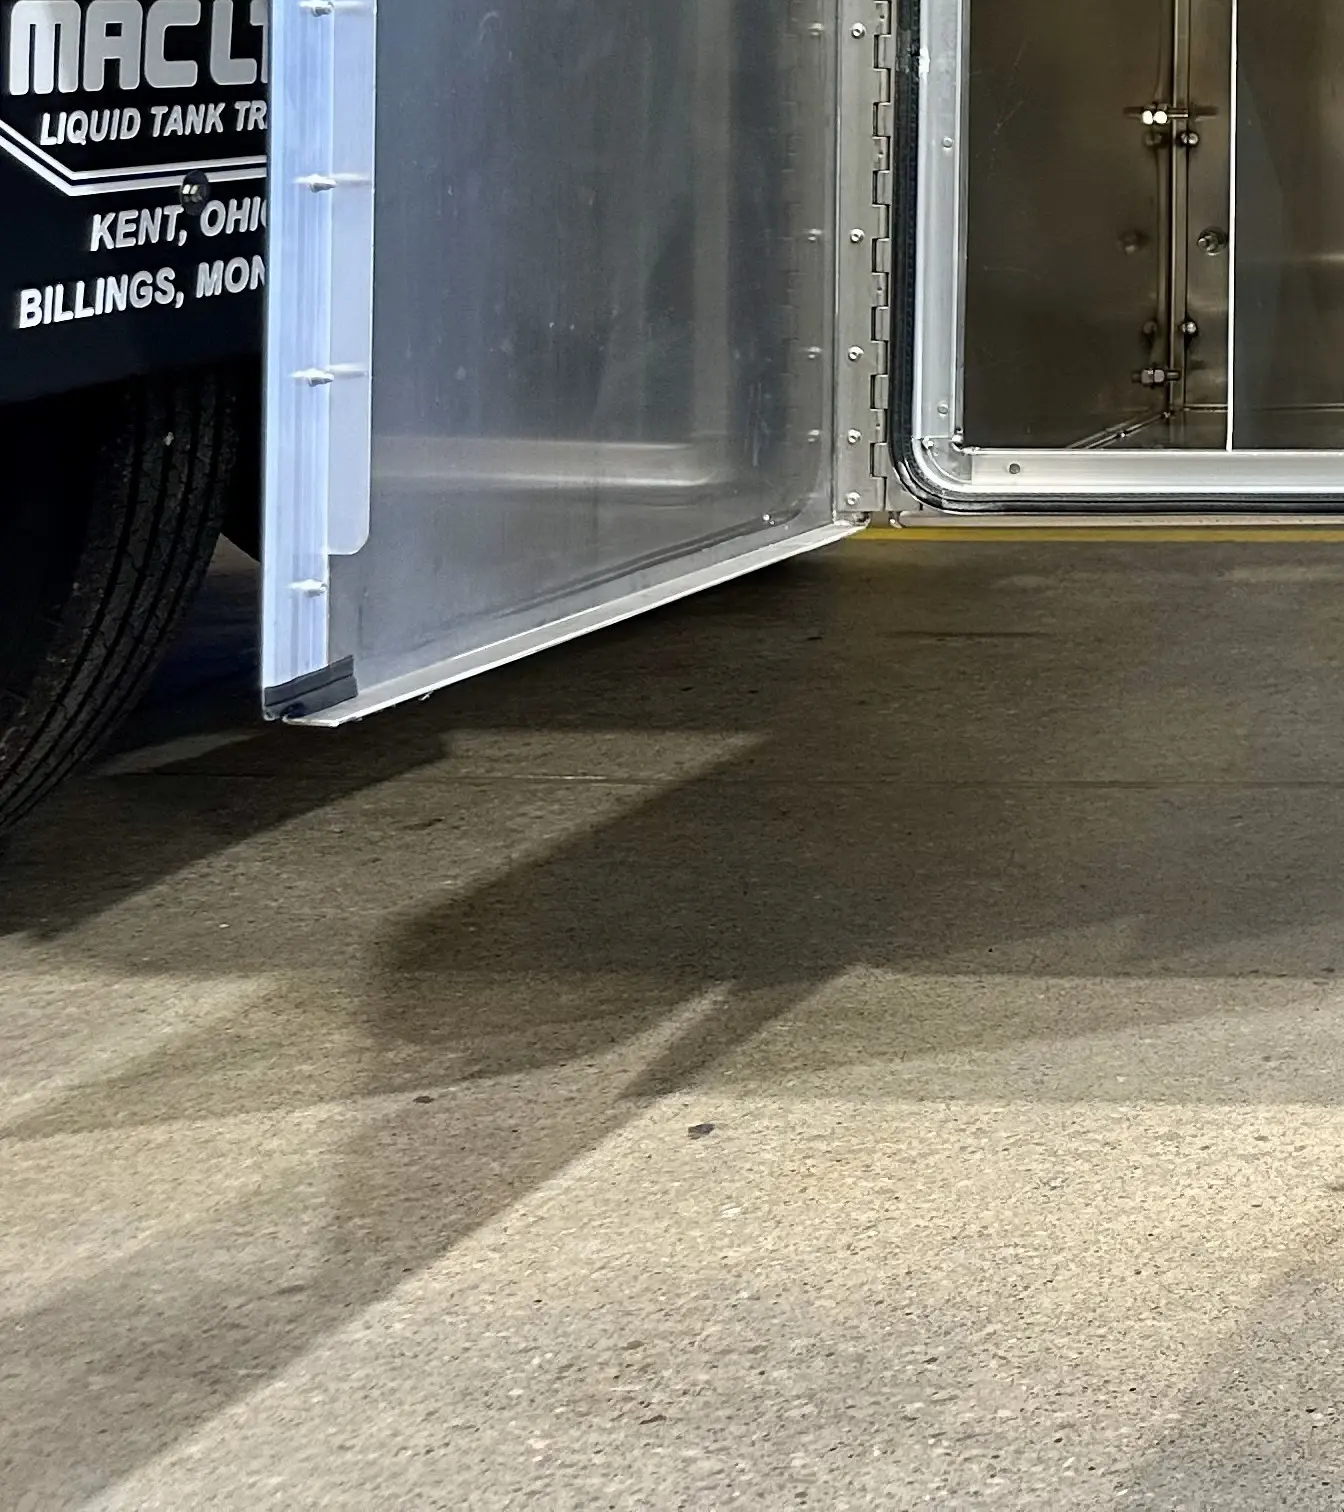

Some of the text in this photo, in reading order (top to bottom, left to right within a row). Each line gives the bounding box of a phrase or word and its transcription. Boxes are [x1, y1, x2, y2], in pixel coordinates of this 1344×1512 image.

[40, 99, 269, 147] LIQUID TANK TR
[90, 204, 189, 253] KENT,
[18, 266, 184, 330] BILLINGS,
